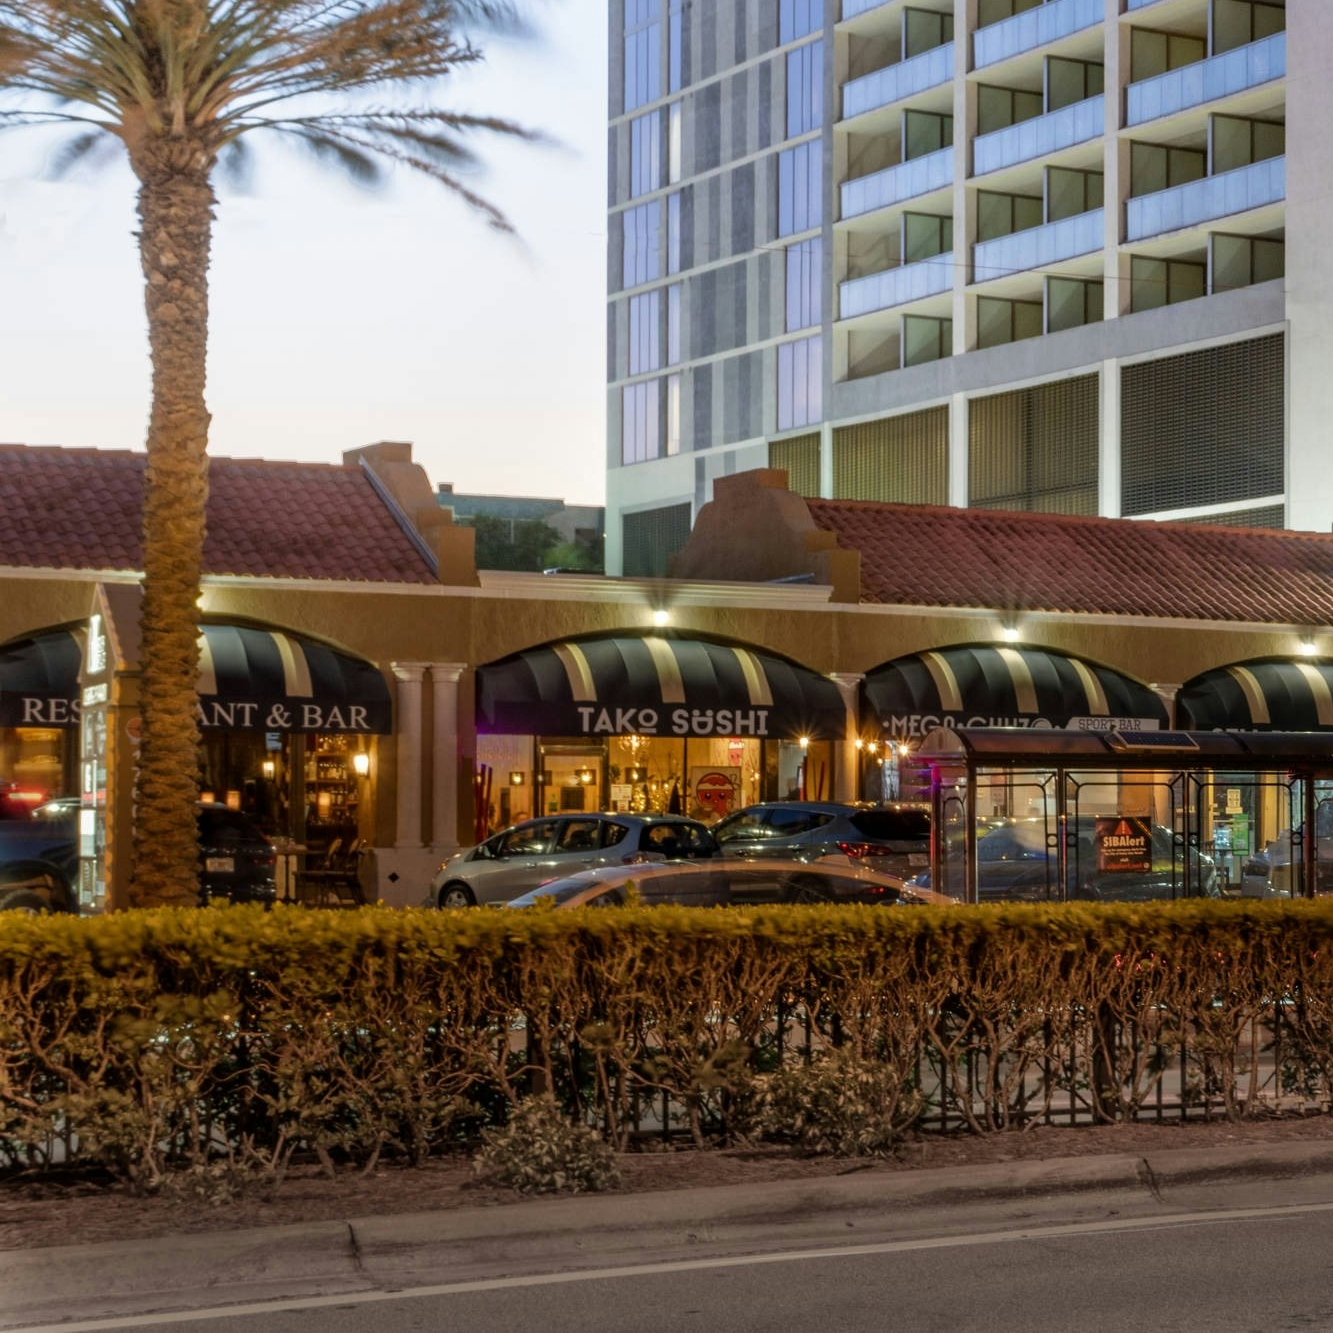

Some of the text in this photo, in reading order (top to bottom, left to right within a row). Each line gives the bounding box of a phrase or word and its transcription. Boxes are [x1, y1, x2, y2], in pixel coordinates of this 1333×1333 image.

[22, 697, 371, 729] RESANT & BAR
[577, 707, 658, 734] TAKO
[1078, 718, 1141, 731] SPORT BAR
